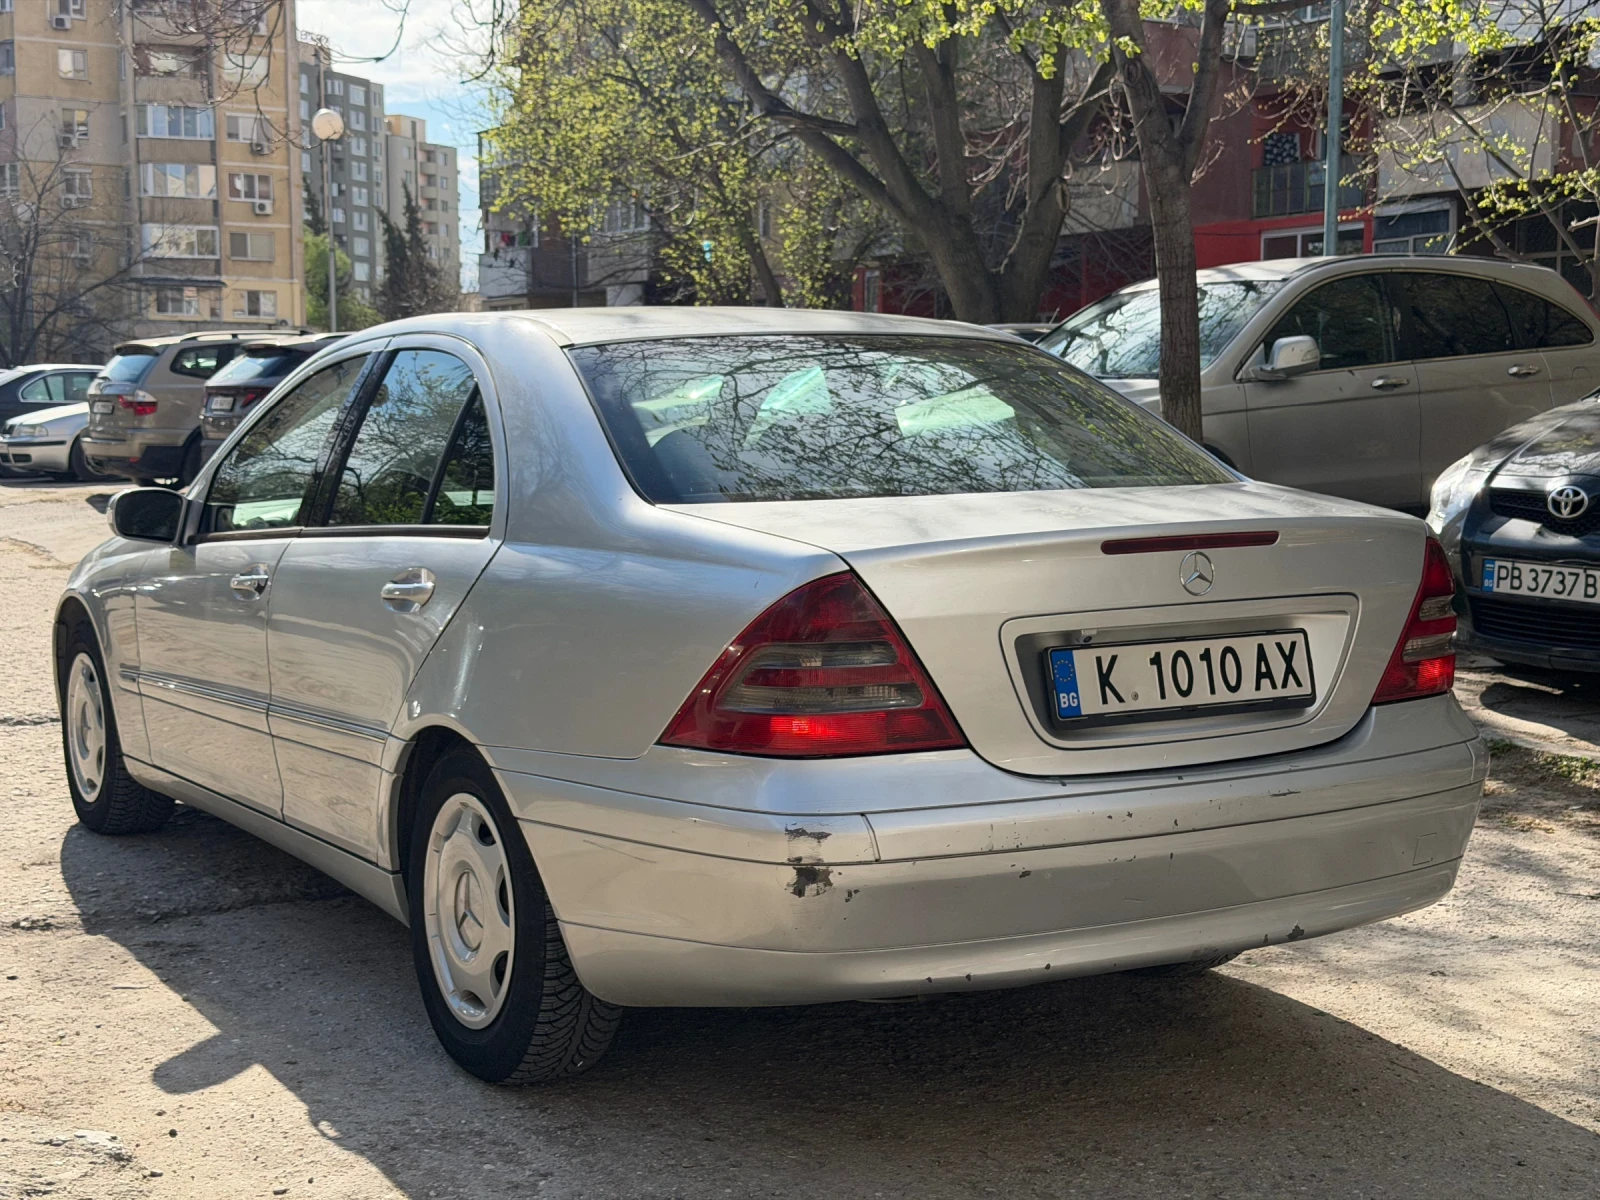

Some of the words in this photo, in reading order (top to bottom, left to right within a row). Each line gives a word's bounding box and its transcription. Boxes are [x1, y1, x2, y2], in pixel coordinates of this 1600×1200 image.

[1496, 565, 1522, 590] PB
[1527, 568, 1580, 596] 3737
[1095, 655, 1125, 705] K
[1149, 646, 1242, 700] 1010
[1255, 640, 1303, 691] AX
[1059, 692, 1078, 708] BG
